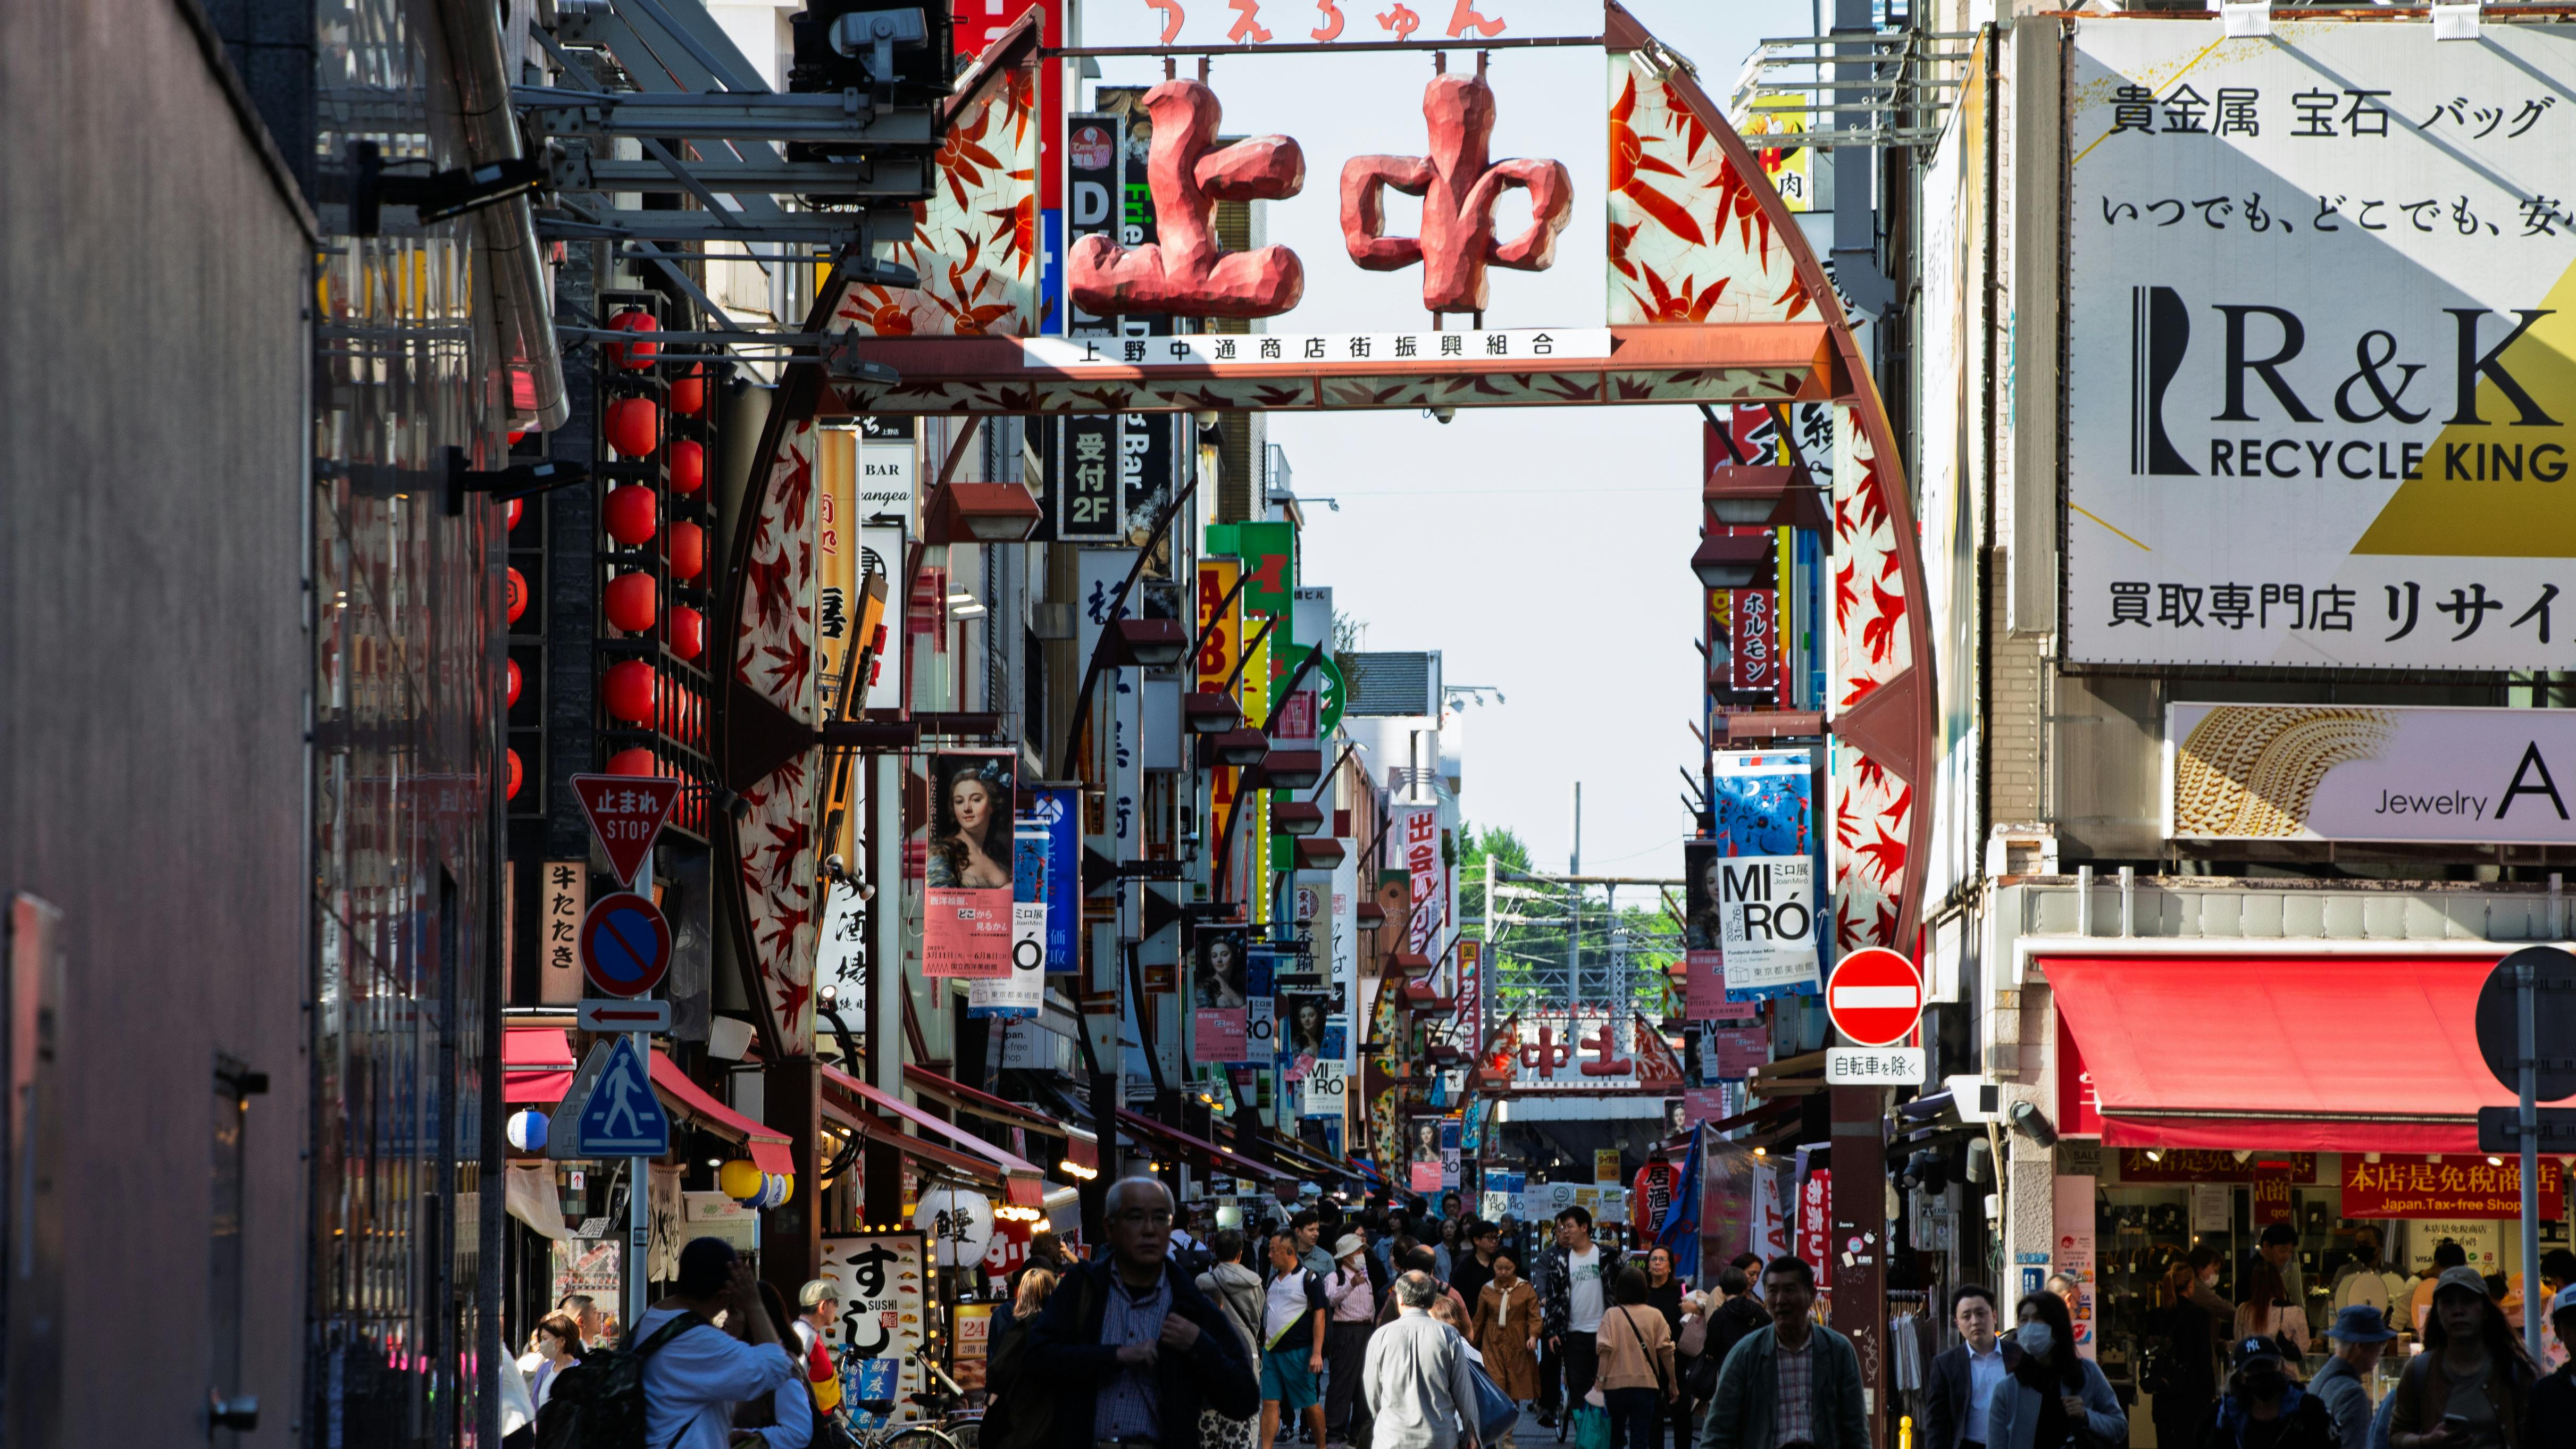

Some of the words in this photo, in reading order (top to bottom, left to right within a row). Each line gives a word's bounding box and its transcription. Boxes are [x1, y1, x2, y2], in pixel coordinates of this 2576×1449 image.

[2108, 83, 2260, 137] 貴金属
[2290, 87, 2392, 138] 宝石
[2418, 96, 2556, 139] バッグ
[1779, 173, 1802, 198] 肉
[2102, 192, 2576, 237] いつでも、どこでも、安
[1079, 332, 1554, 363] 上野中通商店街振興組合
[2211, 304, 2564, 426] R&K
[865, 464, 900, 476] BAR
[1075, 432, 1107, 492] 受付
[2211, 439, 2423, 480] RECYCLE
[2445, 443, 2569, 482] KING
[1073, 497, 1110, 523] 2F
[2107, 581, 2357, 632] 買取専門店
[1743, 593, 1767, 682] ホルモン
[595, 789, 660, 814] 止まれ
[2375, 790, 2488, 820] Jewelry
[607, 820, 650, 840] STOP
[1774, 863, 1809, 876] ミロ展
[1723, 864, 1771, 902] MI
[551, 866, 576, 969] 牛たたき
[959, 909, 992, 919] どこから
[1015, 908, 1043, 919] ミロ展
[1743, 892, 1810, 945] RÓ
[1754, 961, 1815, 977] 東京都美術館
[991, 991, 1040, 1000] 東京都美術館
[1835, 1056, 1916, 1076] 自転車を除く
[1315, 1075, 1344, 1095] RÓ
[2073, 1150, 2101, 1160] SALE
[1646, 1166, 1671, 1232] 居酒屋
[2487, 1198, 2522, 1213] Shop
[842, 1242, 899, 1354] すし
[868, 1299, 897, 1311] SUSHI
[882, 1313, 897, 1328] 鮨
